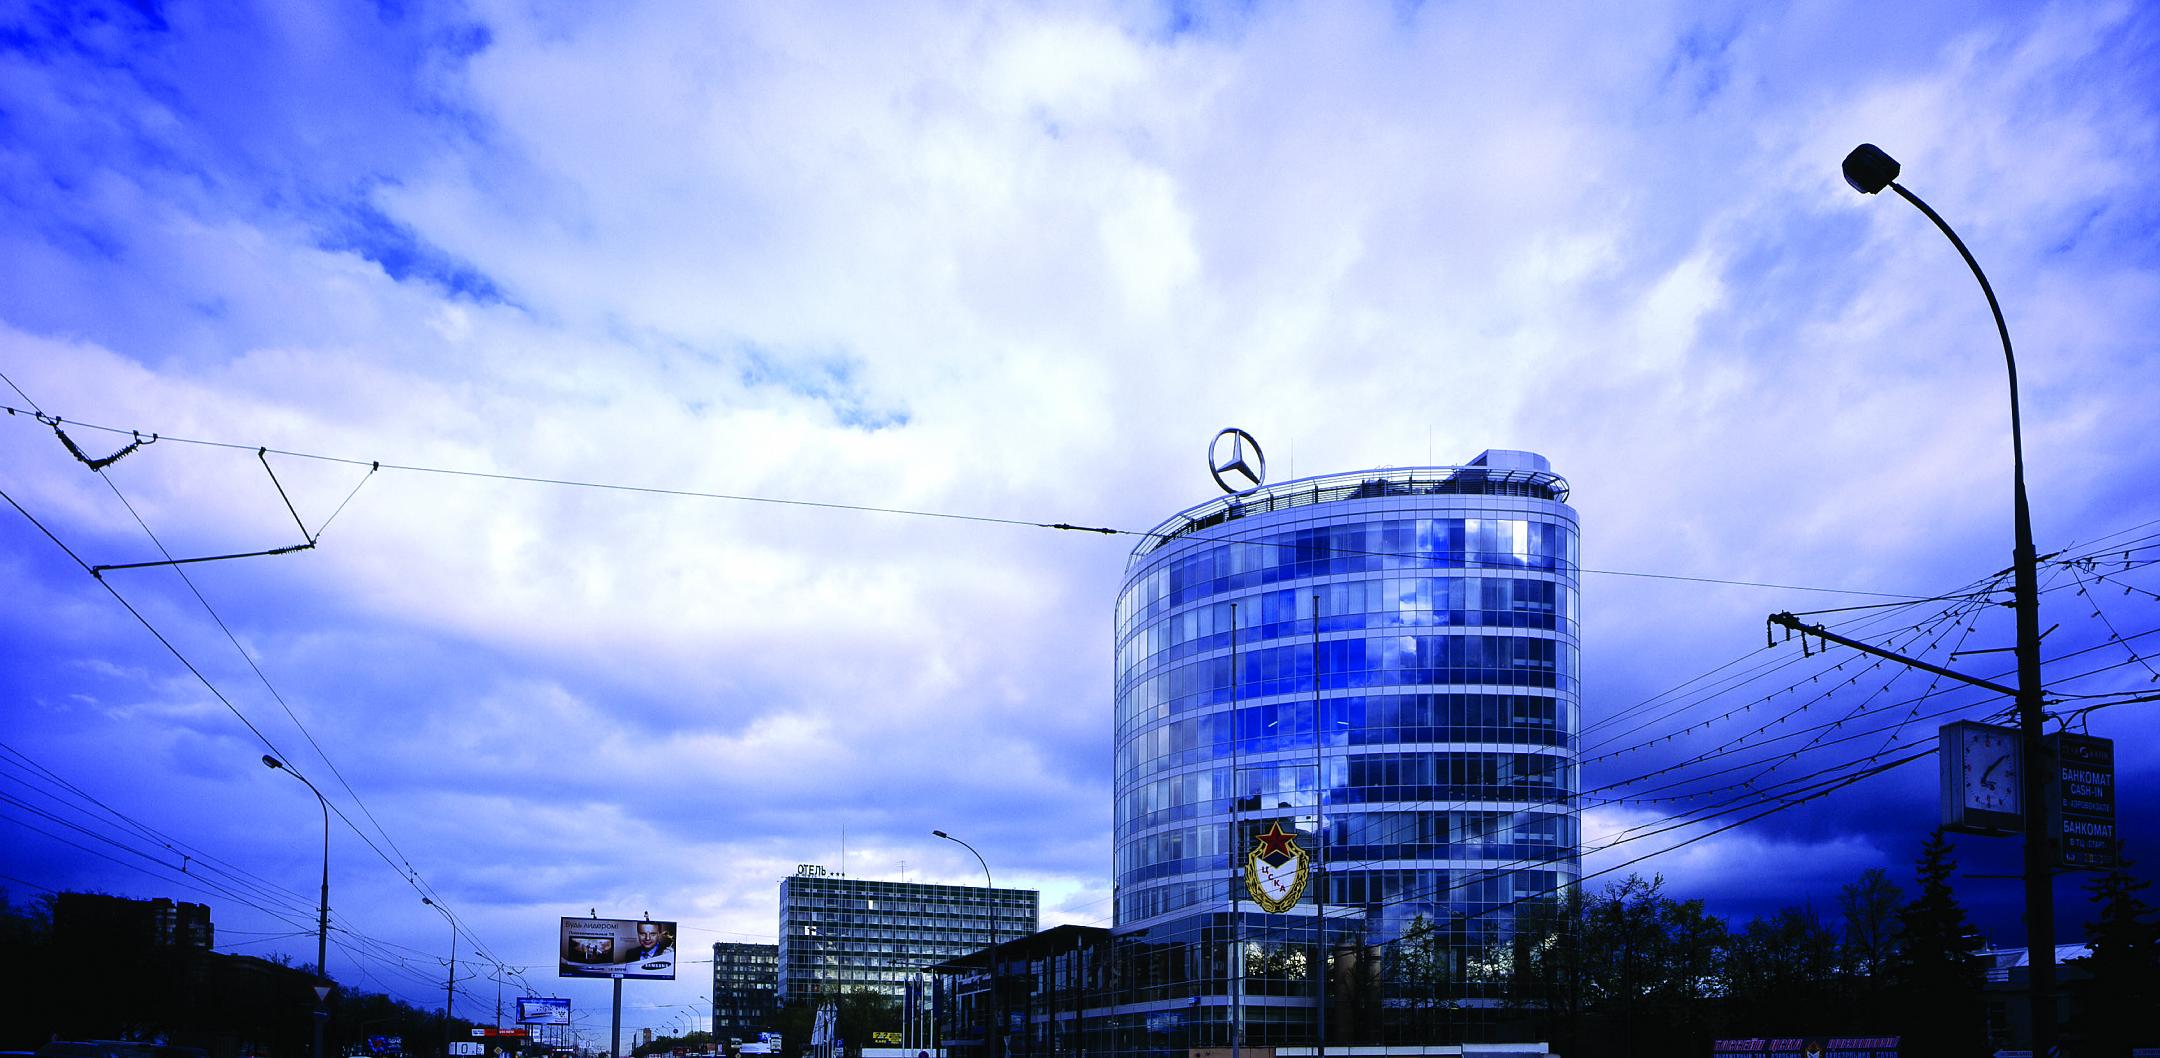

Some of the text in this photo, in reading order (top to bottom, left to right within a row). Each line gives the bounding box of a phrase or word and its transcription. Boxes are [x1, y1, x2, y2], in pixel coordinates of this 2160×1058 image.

[2062, 768, 2111, 784] БАНКОМАТ
[2071, 783, 2103, 798] CASH-IN
[2063, 820, 2113, 837] БАНКОМАТ
[798, 864, 826, 875] ОТЕЛЬ
